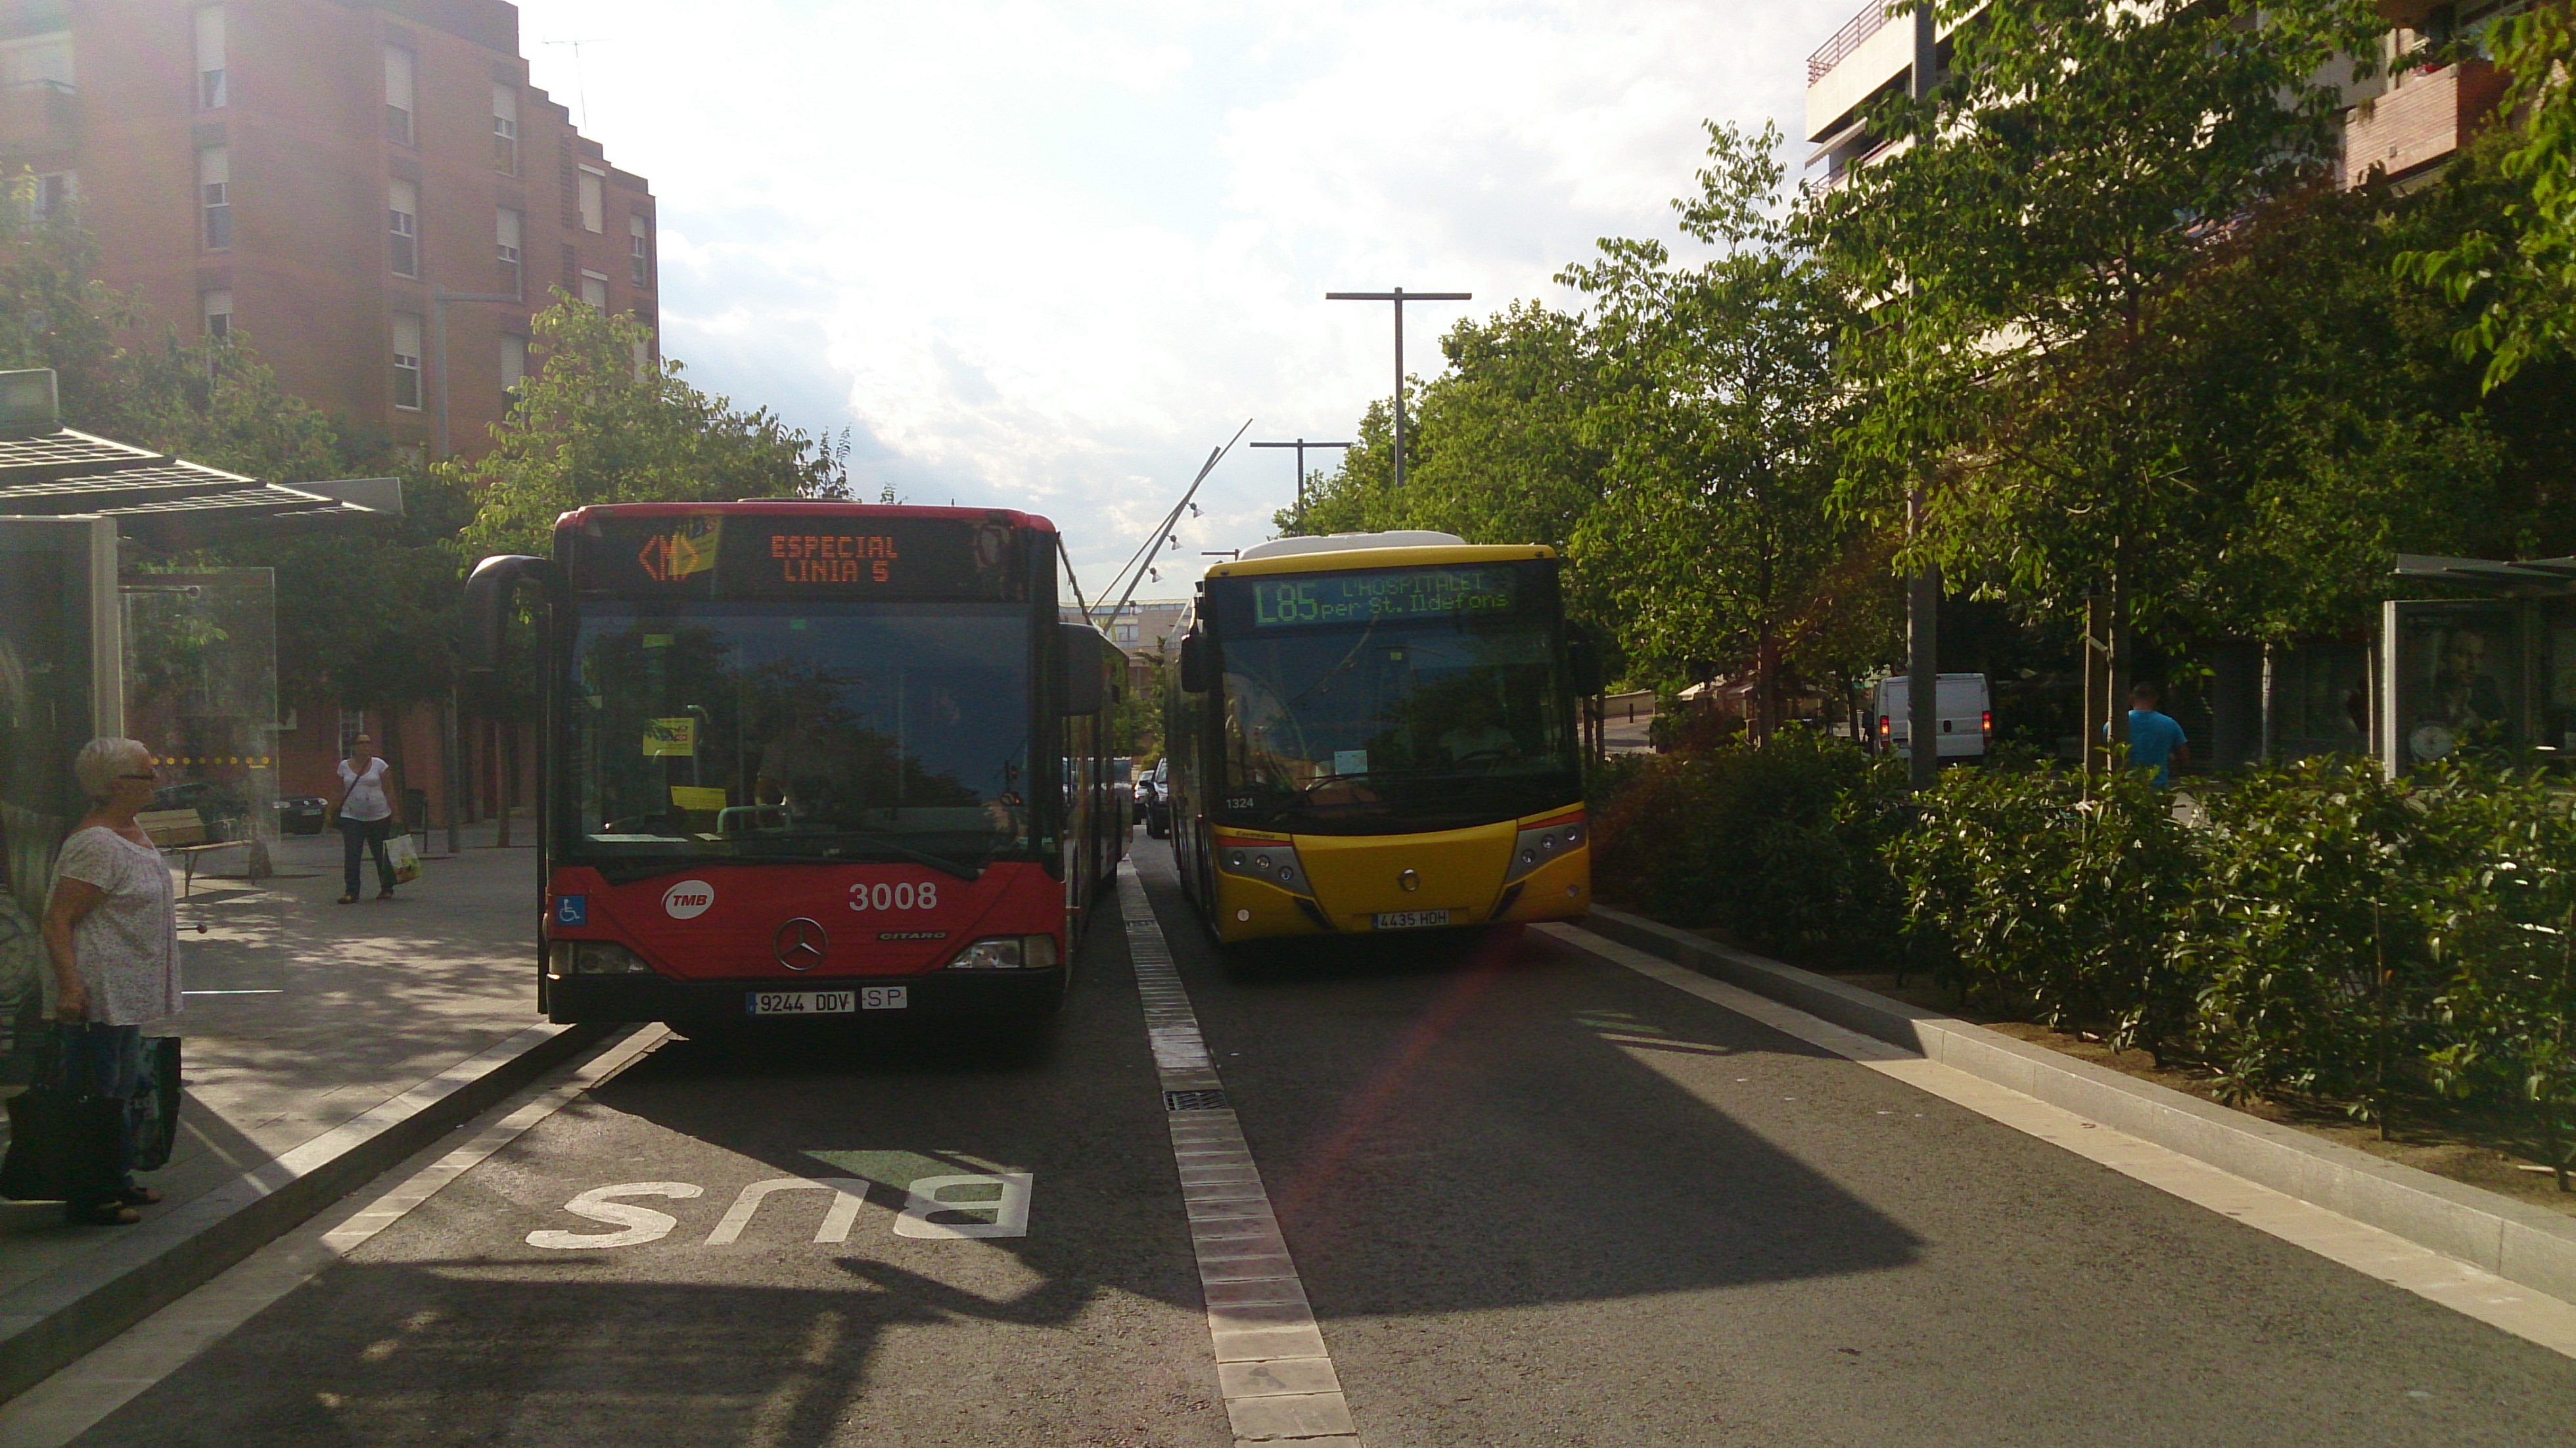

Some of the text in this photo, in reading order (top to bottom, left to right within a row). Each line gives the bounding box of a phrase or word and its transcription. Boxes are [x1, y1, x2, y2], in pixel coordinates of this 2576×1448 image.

[771, 535, 898, 558] ESPECIAL
[783, 560, 857, 582] LINIA
[1343, 573, 1483, 597] L'HOSPITALET
[1255, 582, 1318, 623] L85
[1322, 593, 1510, 620] per St. Ildefons
[1226, 798, 1254, 809] 1324
[672, 894, 708, 907] TMB
[848, 882, 938, 911] 3008
[1381, 911, 1447, 928] 4435 HDH
[879, 932, 946, 941] CITARO
[760, 993, 850, 1012] 9244 DDV
